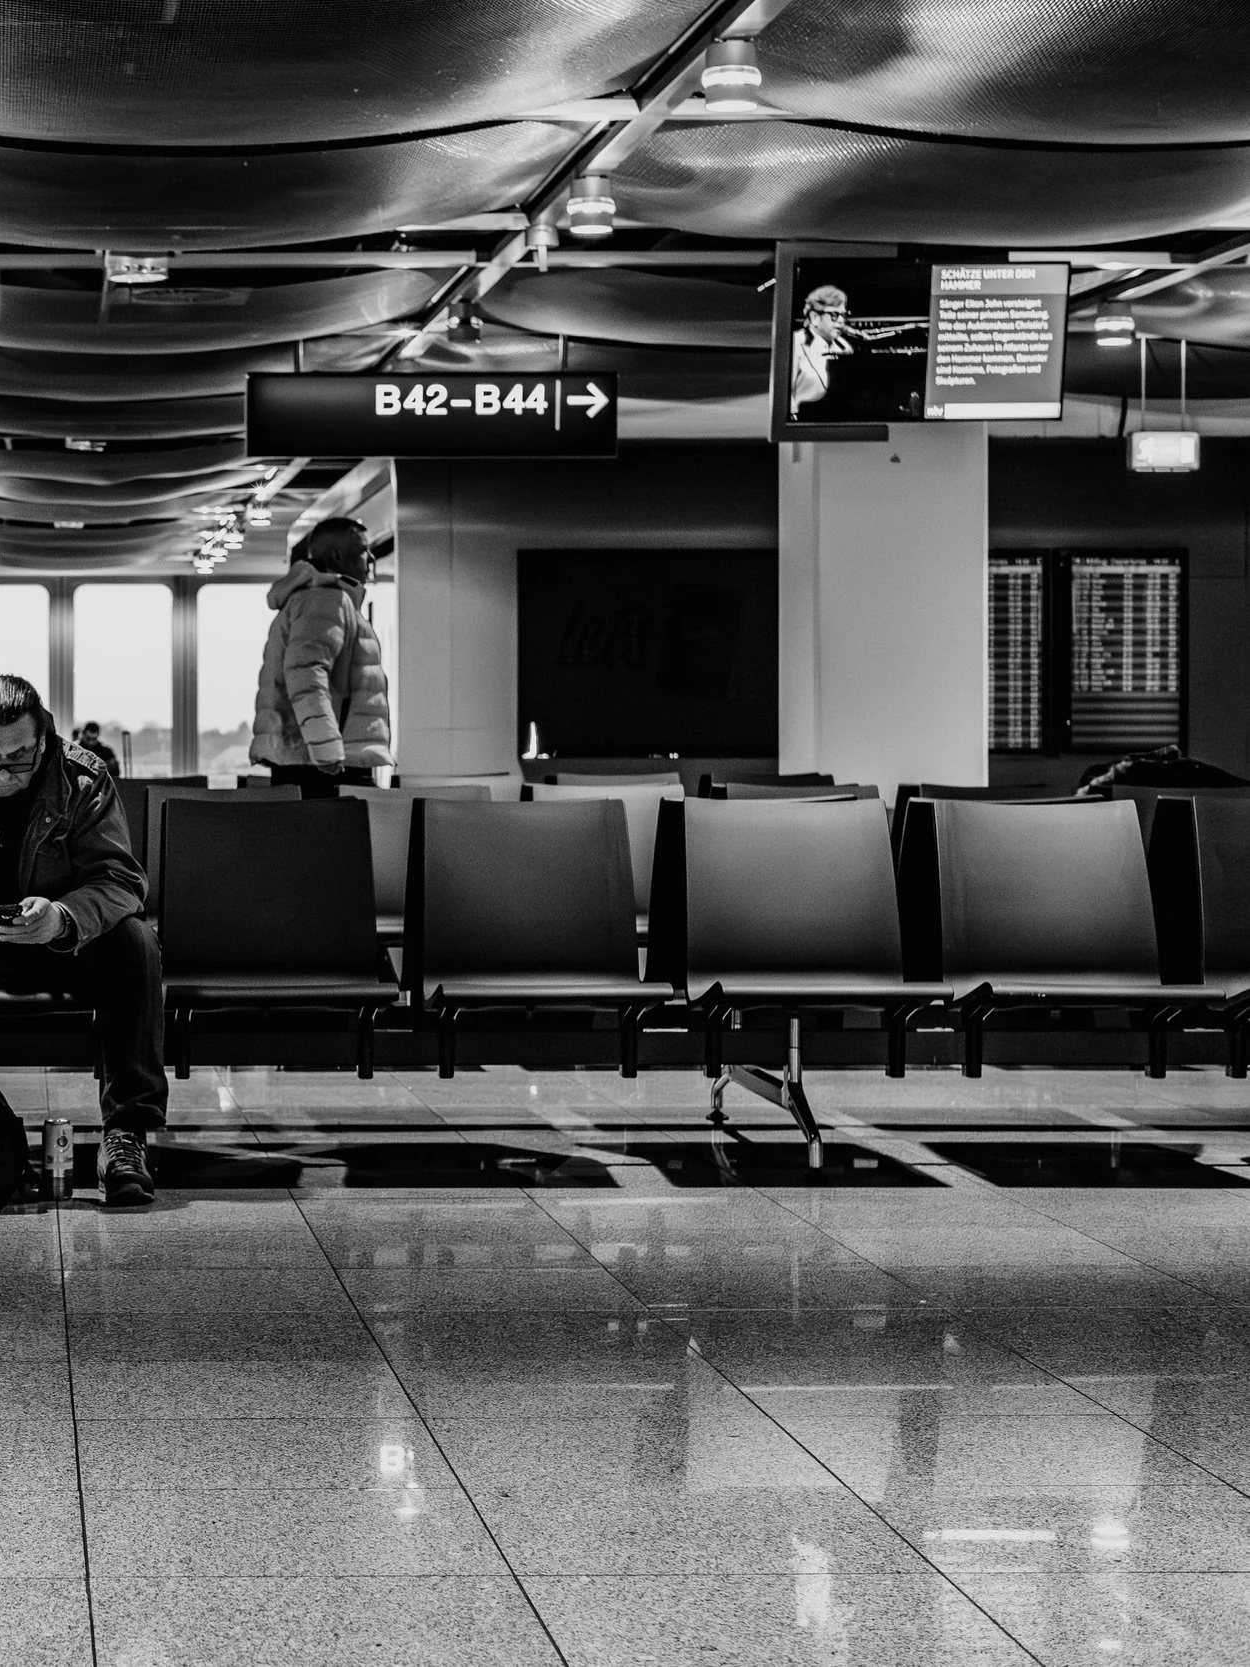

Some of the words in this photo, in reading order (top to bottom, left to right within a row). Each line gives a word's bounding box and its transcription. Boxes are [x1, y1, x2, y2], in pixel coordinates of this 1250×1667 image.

[941, 267, 982, 280] SCHÄTZE
[983, 269, 1014, 279] UNTER
[941, 280, 981, 290] HAMMER
[940, 299, 964, 309] Sänger
[965, 299, 984, 308] Elton
[985, 299, 1002, 308] John
[1003, 299, 1041, 309] versteigert
[940, 311, 956, 319] Teile
[957, 311, 979, 319] seiner
[980, 311, 1009, 320] privaten
[938, 322, 952, 330] Wie
[967, 321, 1014, 330] Auktionshaus
[970, 333, 992, 341] sollen
[993, 332, 1038, 342] Gegenstände
[964, 344, 994, 352] Zuhause
[1003, 343, 1028, 351] Atlanta
[936, 355, 950, 363] den
[952, 355, 982, 363] Hammer
[1017, 354, 1048, 362] Darunter
[936, 366, 951, 374] sind
[986, 364, 1026, 375] Fotografien
[1027, 364, 1041, 373] und
[375, 383, 549, 417] B42-B44
